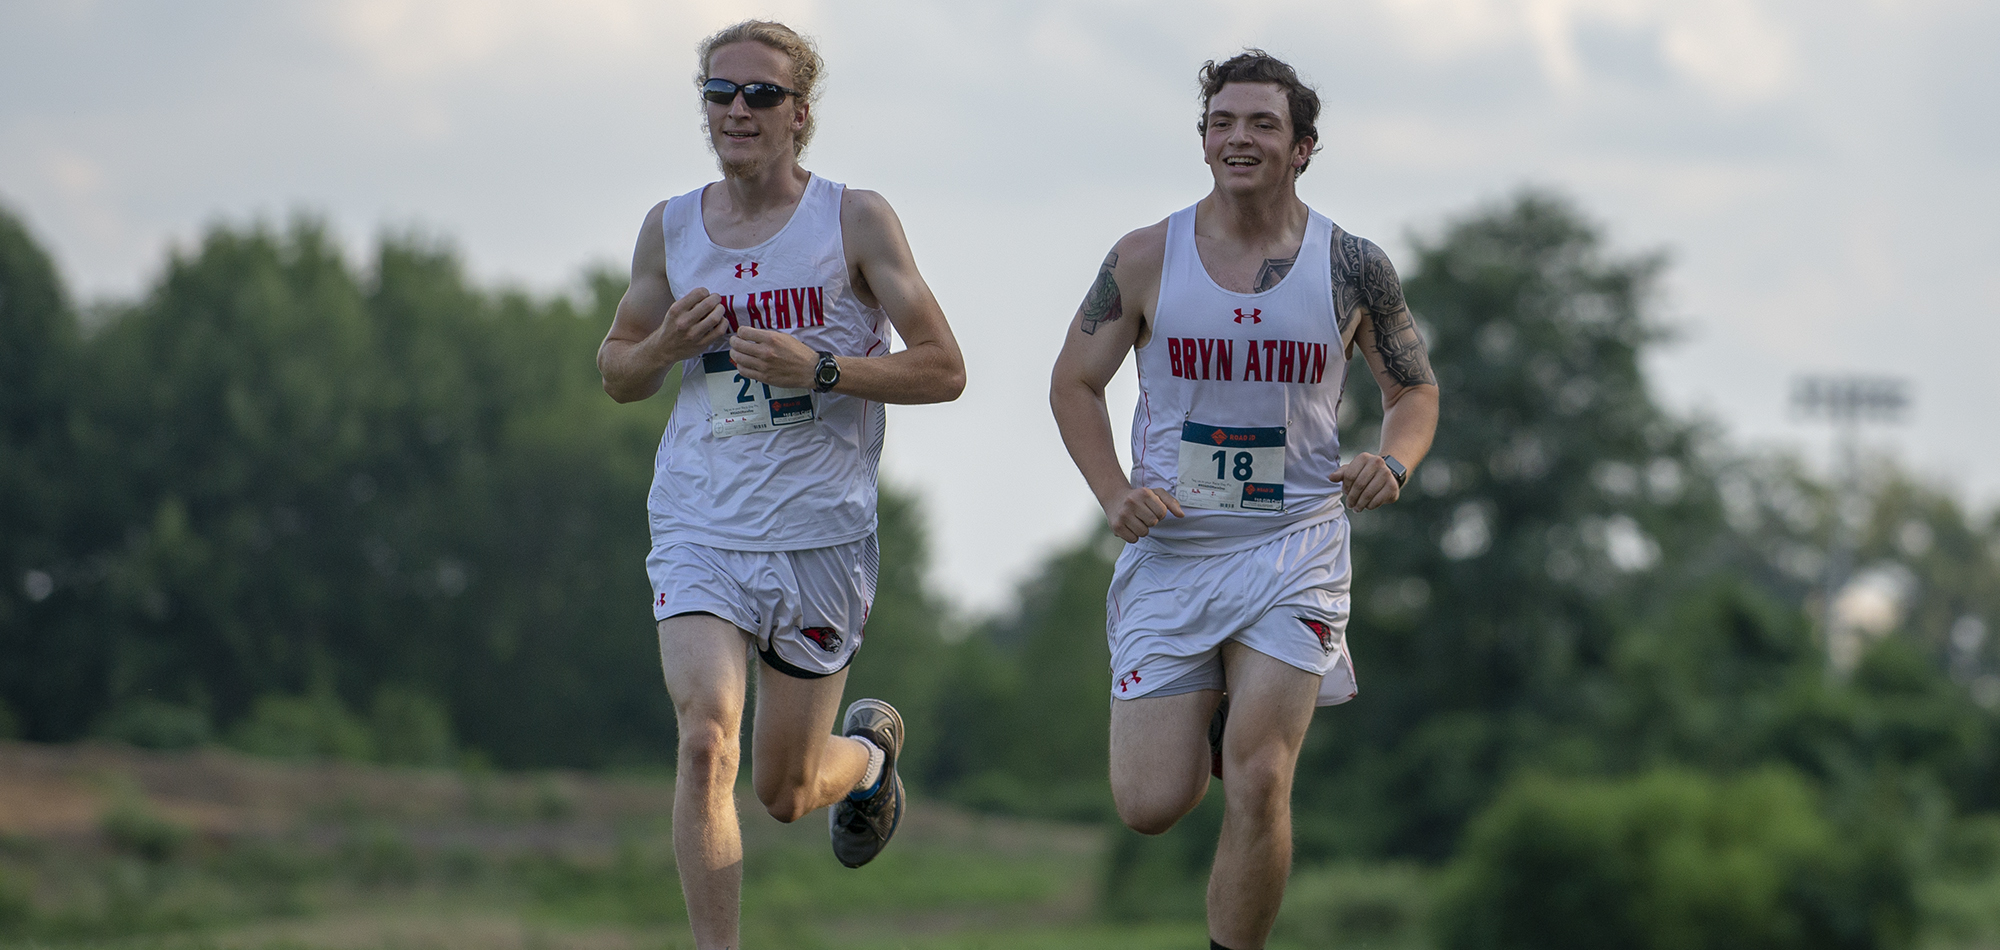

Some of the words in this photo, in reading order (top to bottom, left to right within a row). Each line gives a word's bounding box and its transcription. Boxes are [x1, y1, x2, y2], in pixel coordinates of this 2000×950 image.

[747, 286, 825, 329] ATHYN
[1167, 337, 1234, 381] BRYN
[1243, 340, 1328, 384] ATHYN
[733, 373, 772, 403] 21
[1212, 450, 1253, 481] 18
